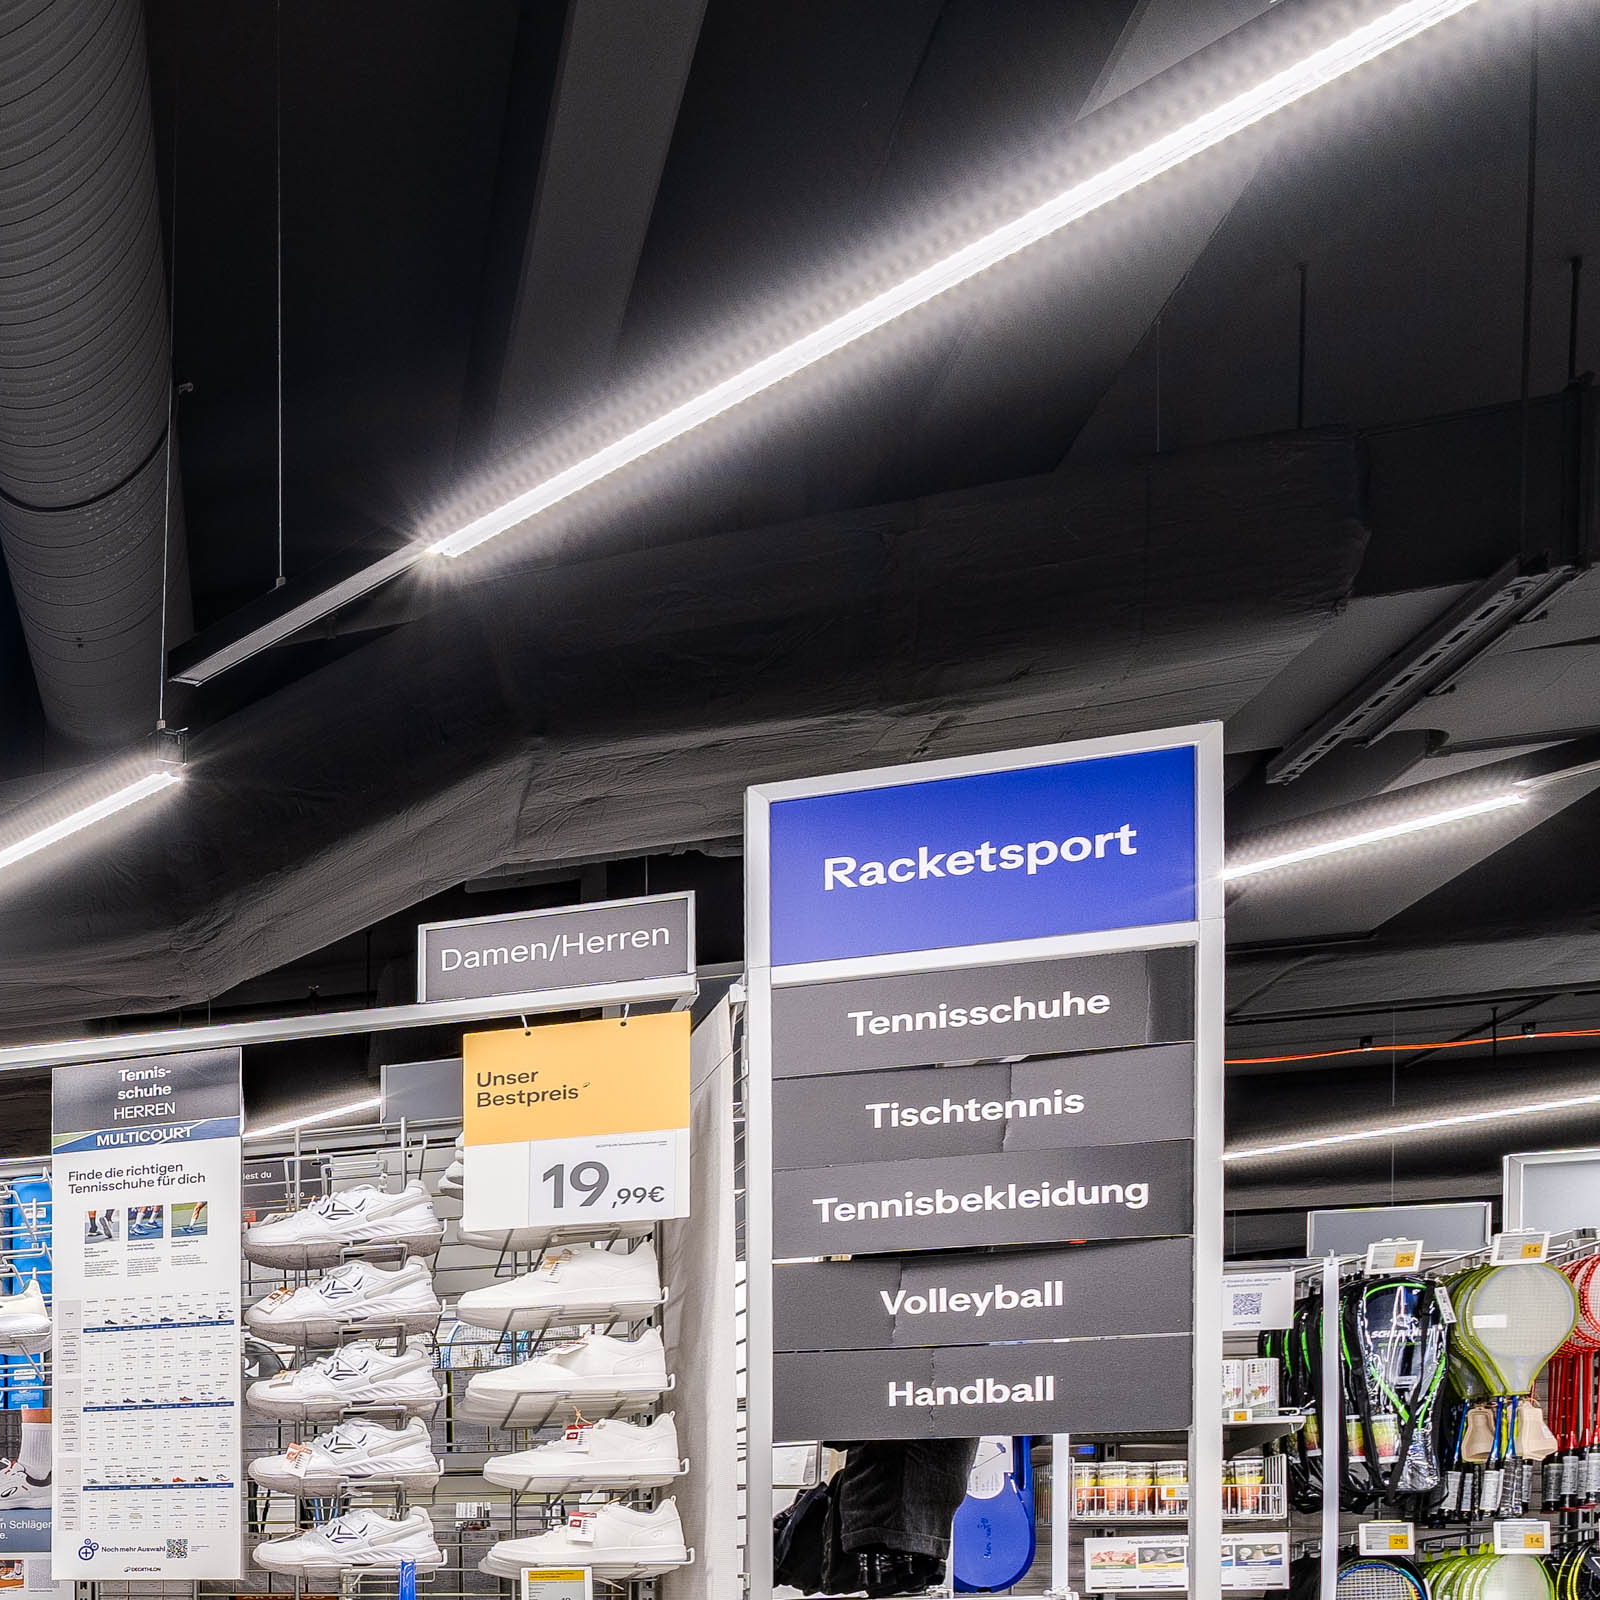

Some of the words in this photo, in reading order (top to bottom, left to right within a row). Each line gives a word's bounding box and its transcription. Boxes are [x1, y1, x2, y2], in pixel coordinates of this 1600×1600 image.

[823, 823, 1138, 891] Racketsport
[441, 927, 670, 972] Damen/Herren
[847, 991, 1111, 1037] Tennisschuhe
[118, 1065, 172, 1082] Tennis-
[476, 1070, 539, 1087] Unser
[117, 1083, 172, 1100] schuhe
[476, 1084, 579, 1108] Bestpreis
[113, 1102, 176, 1120] HERREN
[864, 1088, 1086, 1129] Tischtennis
[96, 1127, 193, 1147] MULTICOURT
[68, 1169, 103, 1182] Finde
[104, 1167, 124, 1179] die
[126, 1163, 184, 1177] richtigen
[68, 1177, 155, 1194] Tennisschuhe
[157, 1175, 176, 1186] für
[178, 1173, 206, 1185] dich
[543, 1161, 665, 1209] 19,99€
[812, 1180, 1150, 1223] Tennisbekleidung
[879, 1280, 1064, 1317] Volleyball
[887, 1375, 1055, 1407] Handball
[137, 1545, 166, 1553] Auswahl
